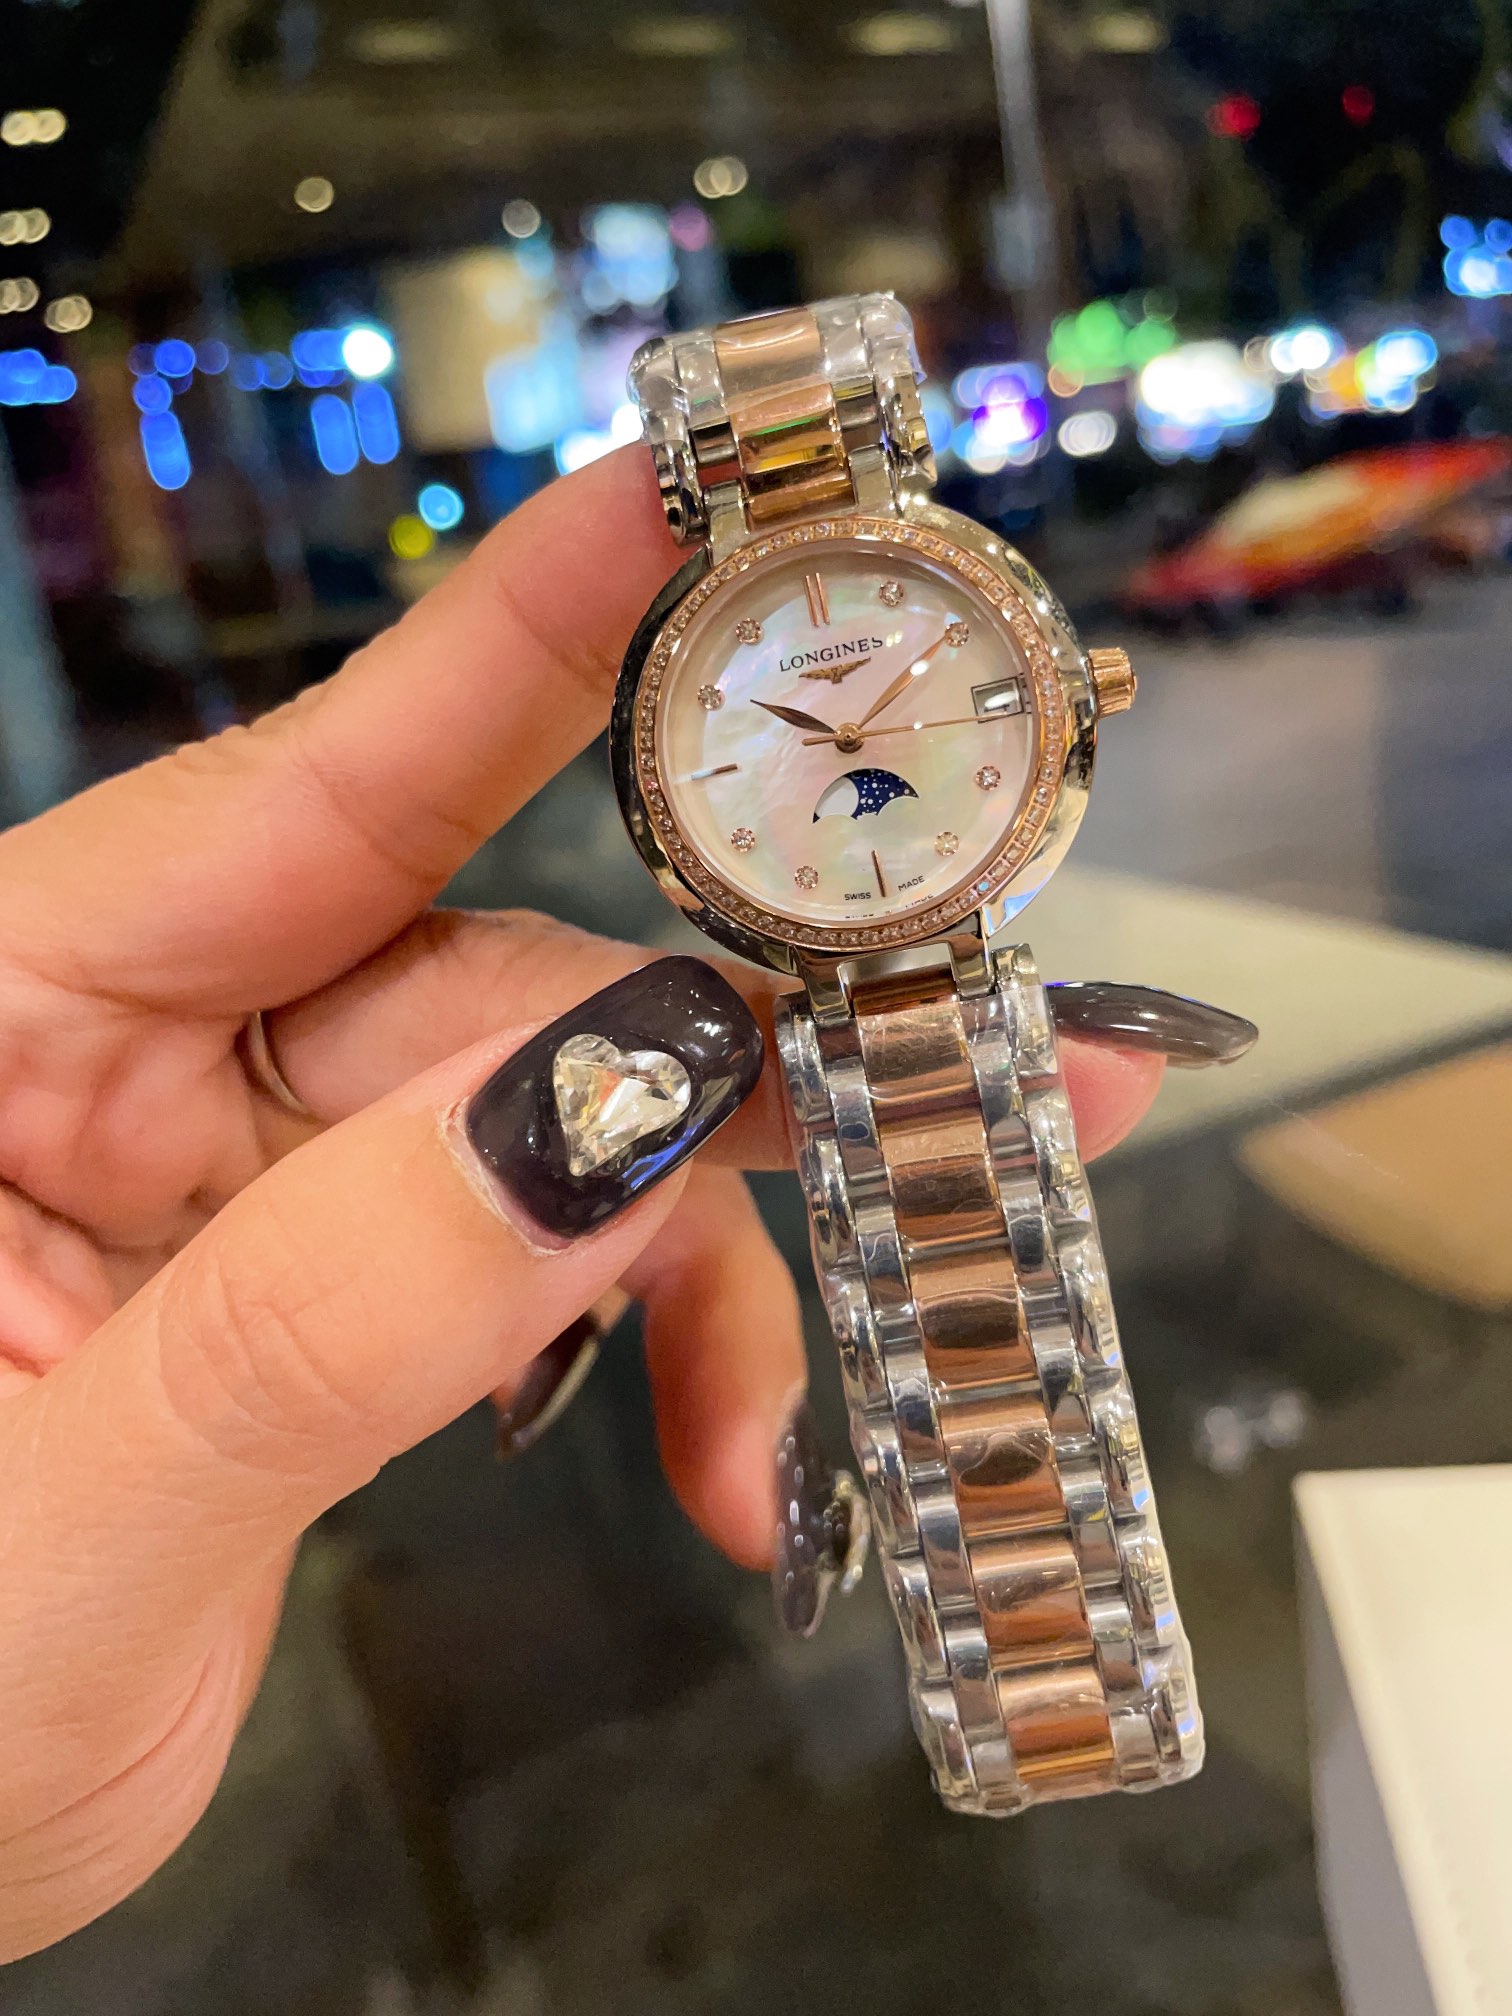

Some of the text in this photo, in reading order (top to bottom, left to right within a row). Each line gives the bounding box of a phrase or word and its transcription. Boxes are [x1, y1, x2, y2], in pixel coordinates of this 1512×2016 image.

[779, 637, 883, 672] LONGINES
[844, 875, 925, 901] SWISS MADE
